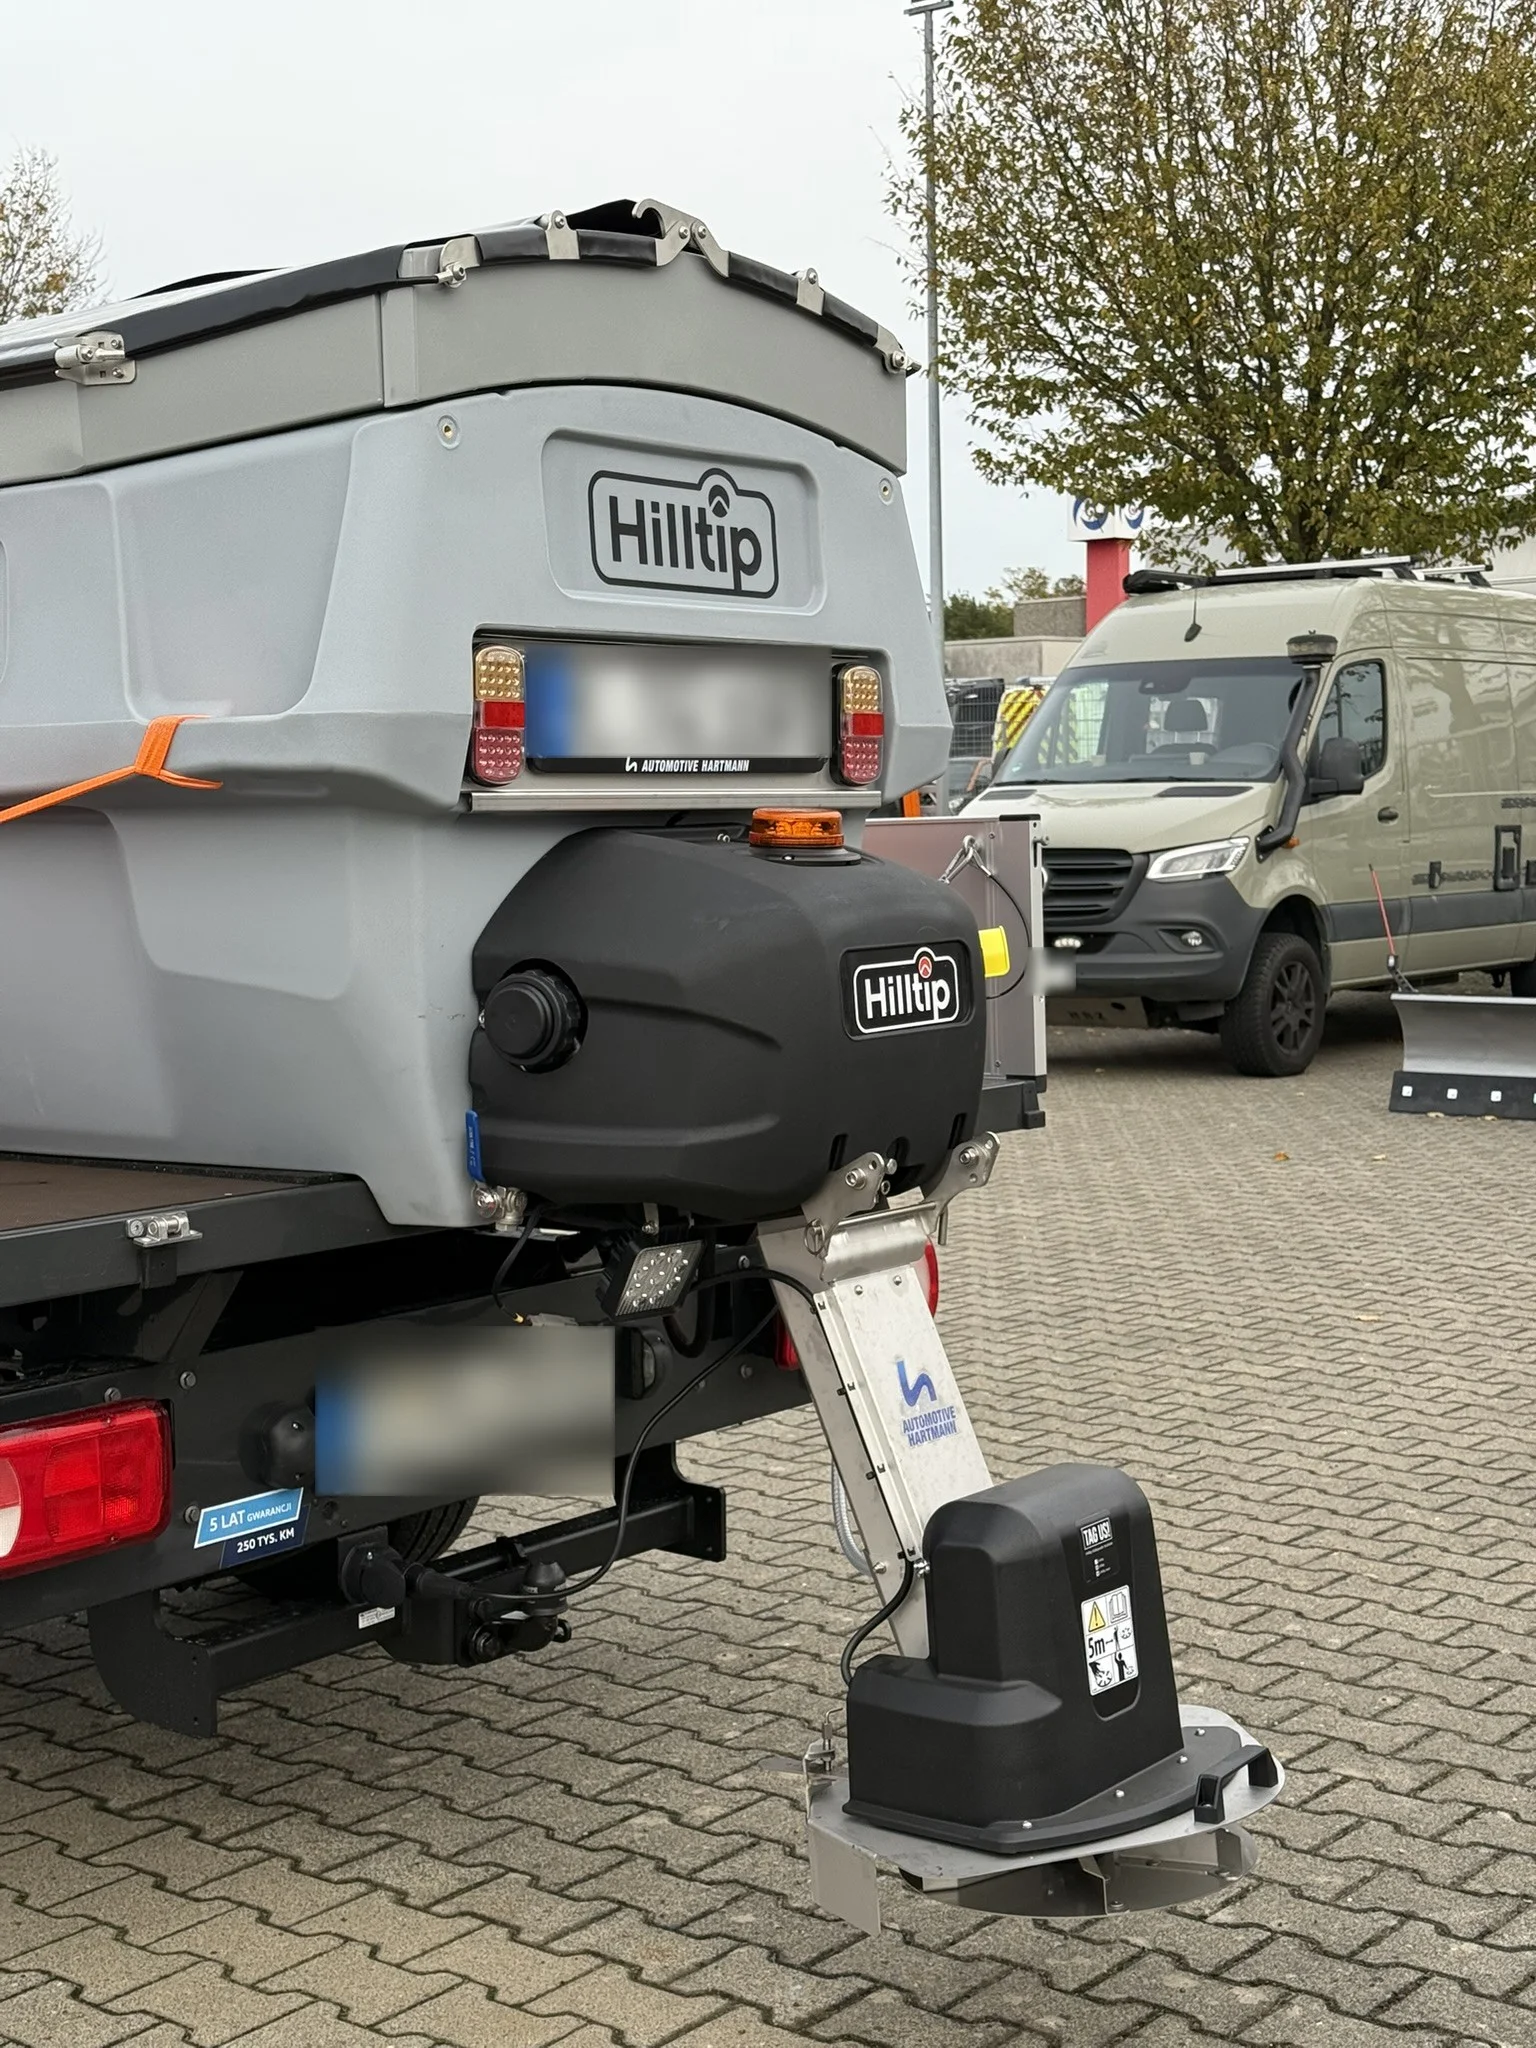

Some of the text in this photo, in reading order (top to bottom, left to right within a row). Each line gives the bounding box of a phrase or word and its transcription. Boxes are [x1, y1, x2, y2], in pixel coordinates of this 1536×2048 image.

[609, 485, 762, 590] Hilltip
[641, 759, 700, 772] AUTOMOTIVE
[701, 759, 750, 772] HARTMANN
[864, 957, 951, 1020] Hilltip
[903, 1405, 957, 1434] AUTOMOTIVE
[907, 1420, 957, 1447] HARTMANN
[209, 1502, 292, 1532] 5 LAT GWARANCJI
[236, 1527, 295, 1554] 250 TYS. KM
[1082, 1526, 1098, 1546] TAG
[1088, 1637, 1106, 1659] 5m
